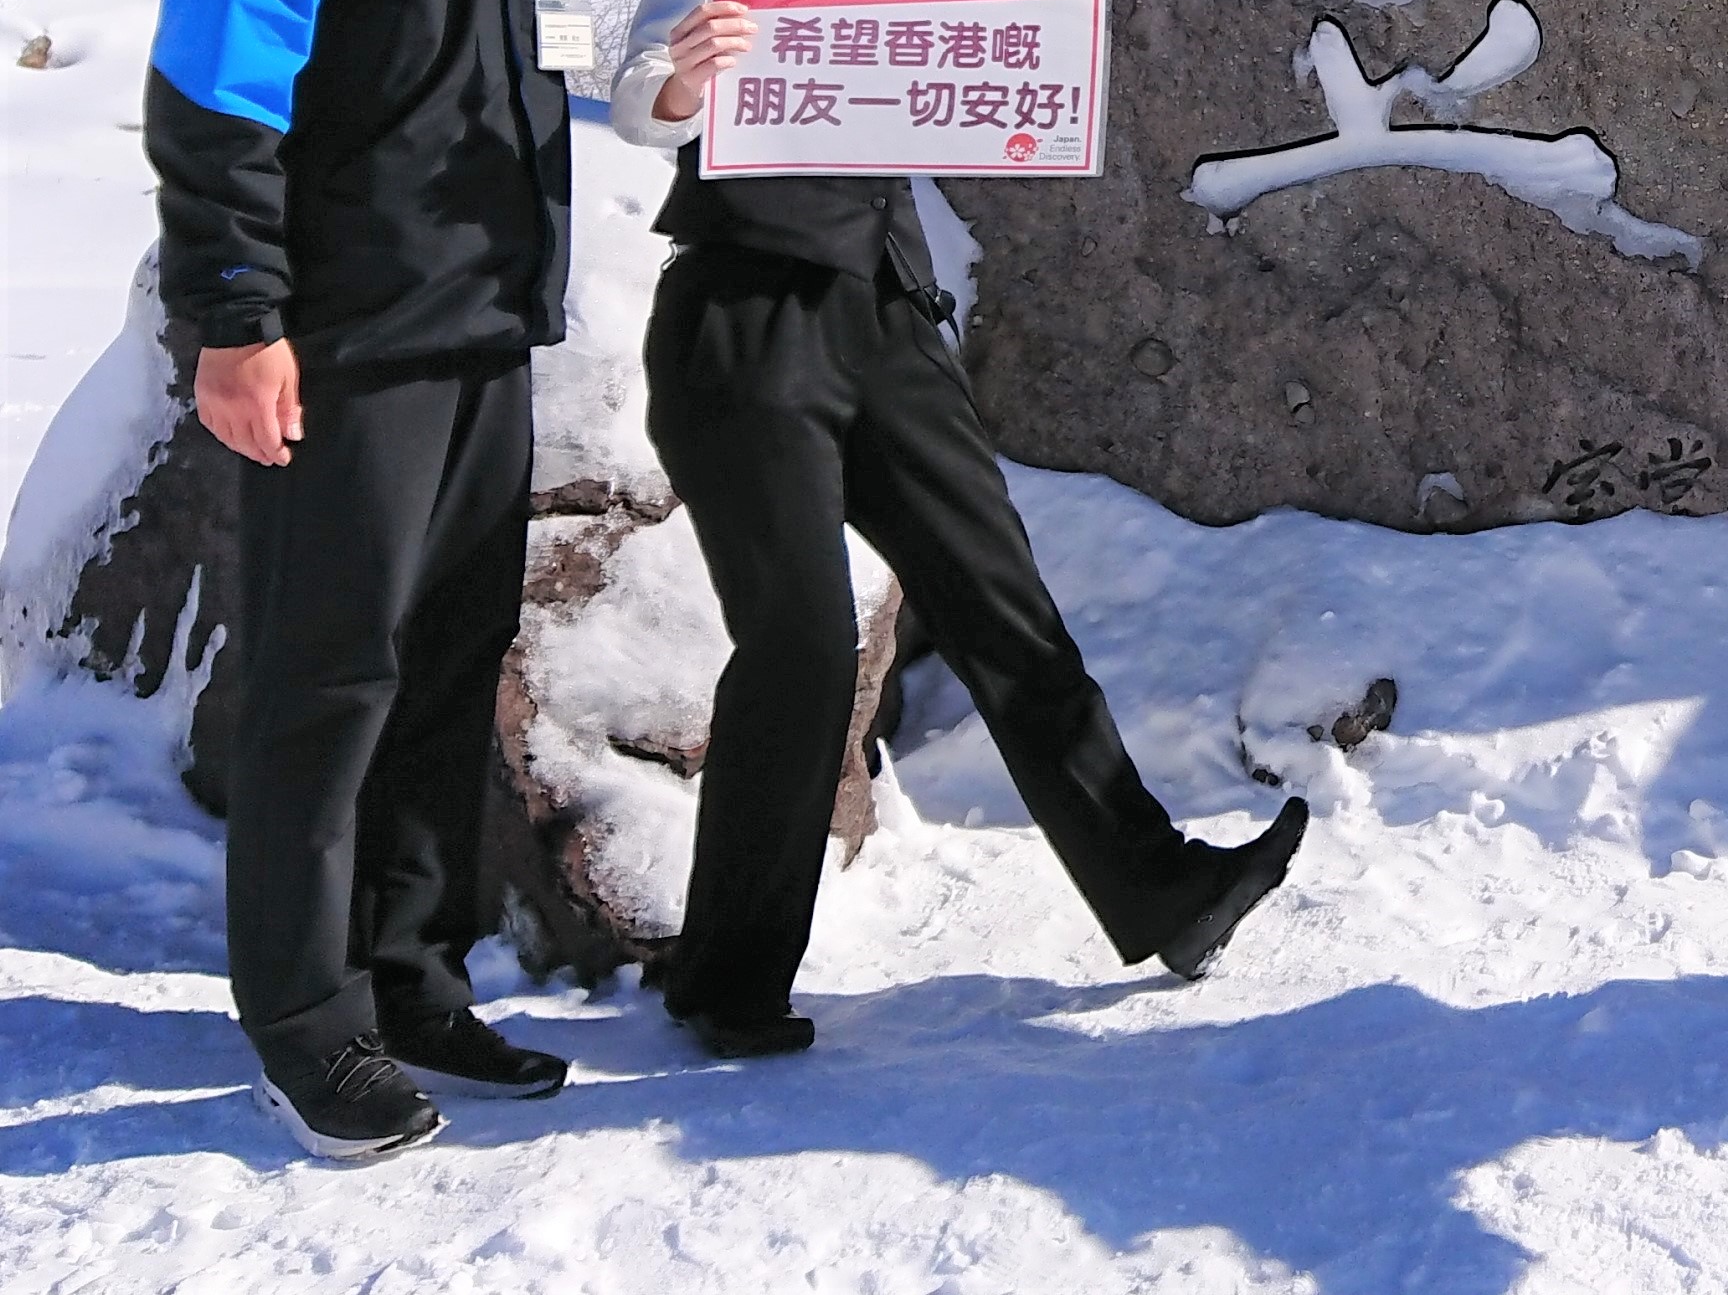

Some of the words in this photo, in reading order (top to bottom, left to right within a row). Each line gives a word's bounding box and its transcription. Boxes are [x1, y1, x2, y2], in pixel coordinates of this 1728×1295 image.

[771, 16, 1041, 70] 希望香港嘅
[733, 77, 1081, 130] 朋友一切安好!
